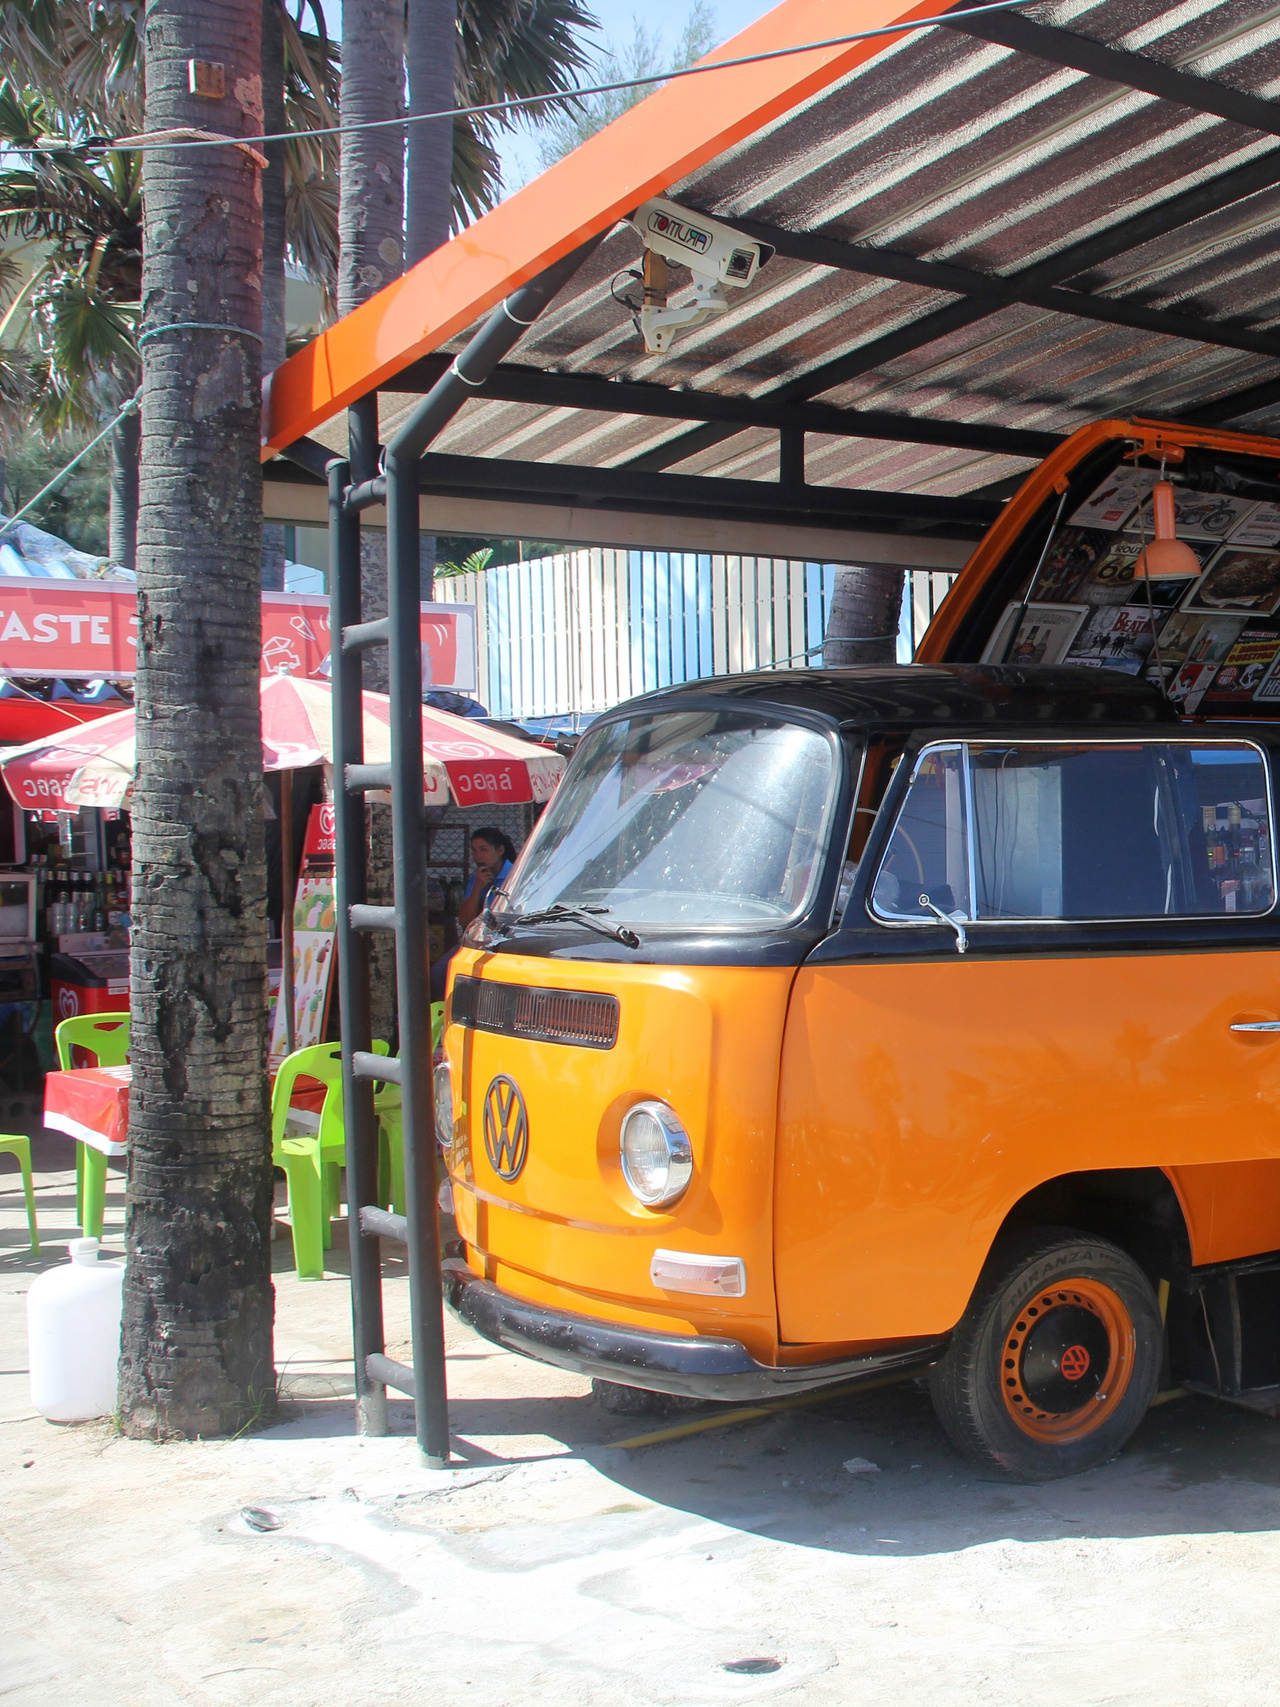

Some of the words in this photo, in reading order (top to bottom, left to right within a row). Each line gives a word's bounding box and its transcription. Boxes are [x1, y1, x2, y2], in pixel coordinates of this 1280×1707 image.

[654, 212, 707, 250] TOMURA
[1115, 545, 1142, 554] ROUT
[1097, 557, 1137, 580] 66
[0, 610, 111, 645] ASTE
[458, 767, 513, 792] วอลล์
[1007, 1251, 1094, 1306] TURANZA
